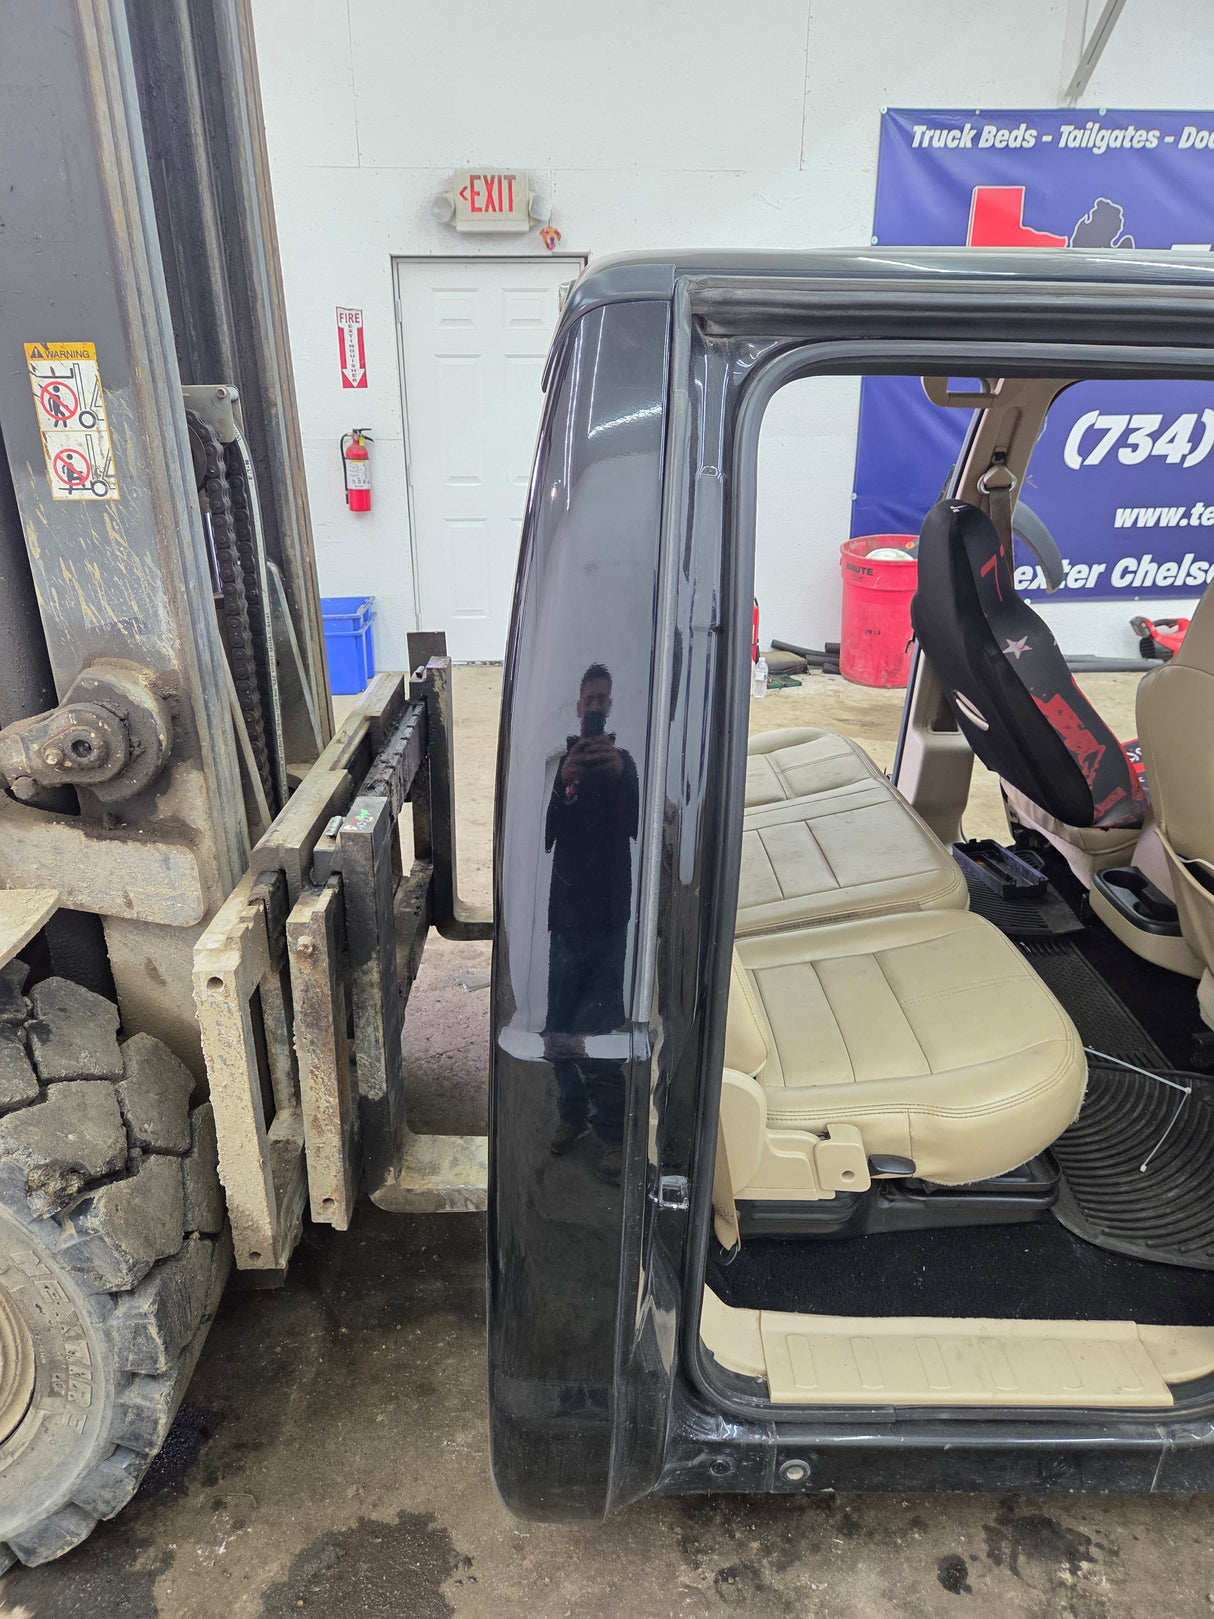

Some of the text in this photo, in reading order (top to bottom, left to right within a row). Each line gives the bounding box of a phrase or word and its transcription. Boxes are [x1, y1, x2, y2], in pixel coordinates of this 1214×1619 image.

[911, 122, 977, 149] Truck
[977, 122, 1038, 149] Beds
[1058, 121, 1161, 155] Tailgates
[469, 174, 517, 213] EXIT
[339, 312, 360, 324] FIRE
[44, 349, 91, 359] WARNING
[346, 324, 358, 384] EXTINGUISHER
[1063, 408, 1214, 470] (734)
[846, 561, 874, 577] BRUTE
